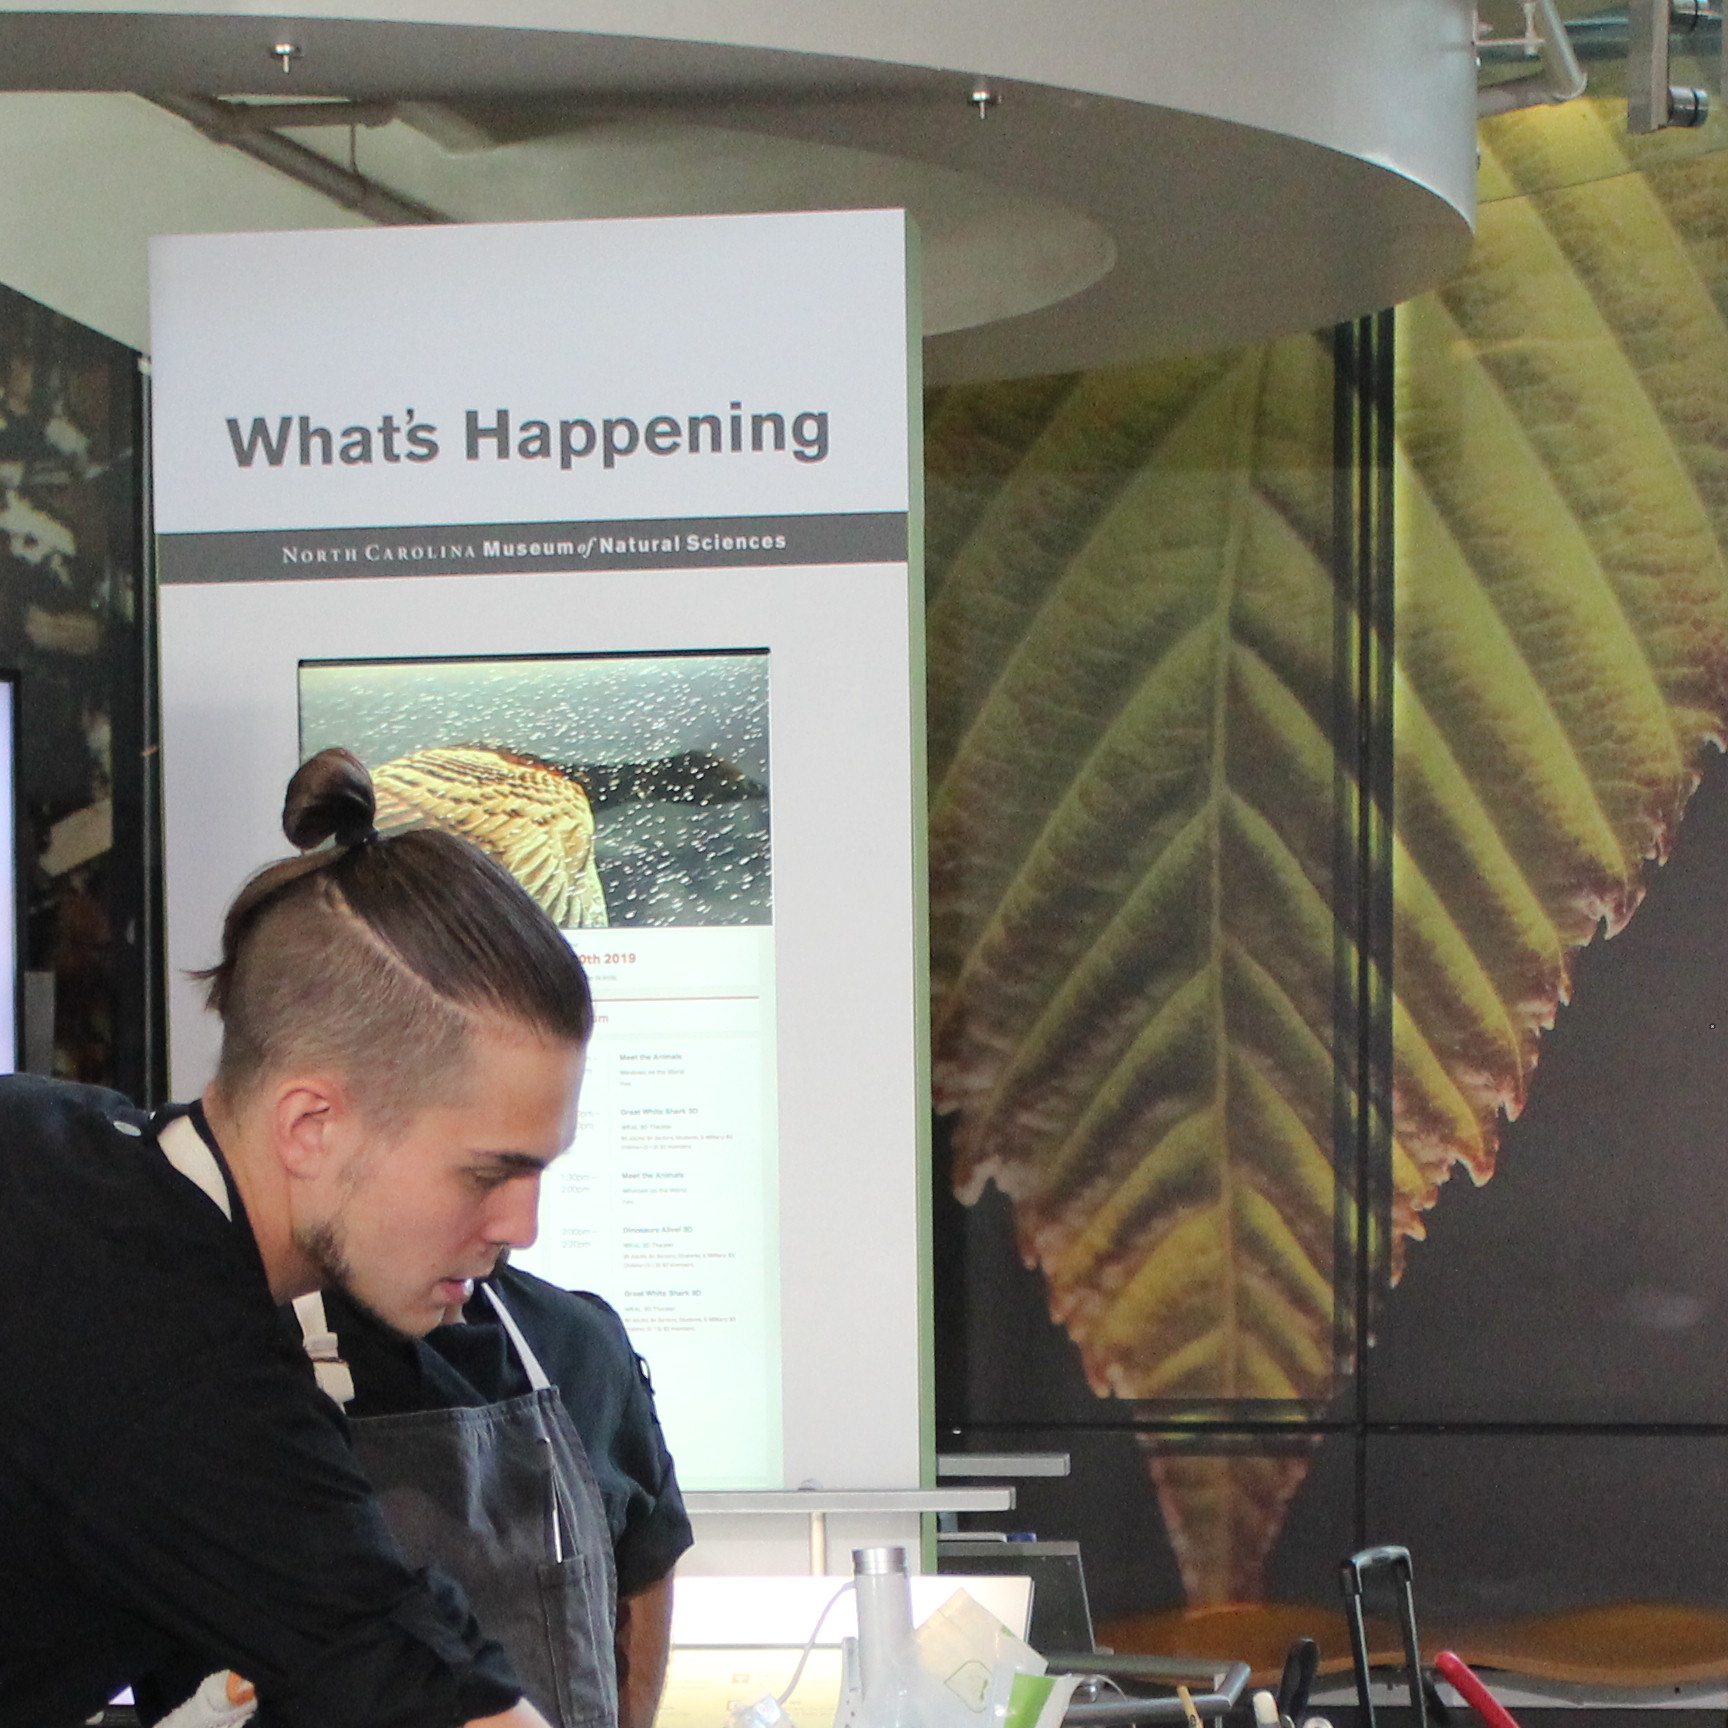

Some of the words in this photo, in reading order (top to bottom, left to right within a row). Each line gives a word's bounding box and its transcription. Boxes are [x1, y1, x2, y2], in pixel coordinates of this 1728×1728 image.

[226, 409, 440, 468] What's
[464, 400, 829, 470] Happening
[482, 540, 574, 559] Museum
[577, 537, 597, 558] of
[599, 535, 681, 555] Natural
[686, 533, 787, 552] Sciences
[604, 952, 637, 965] 2019
